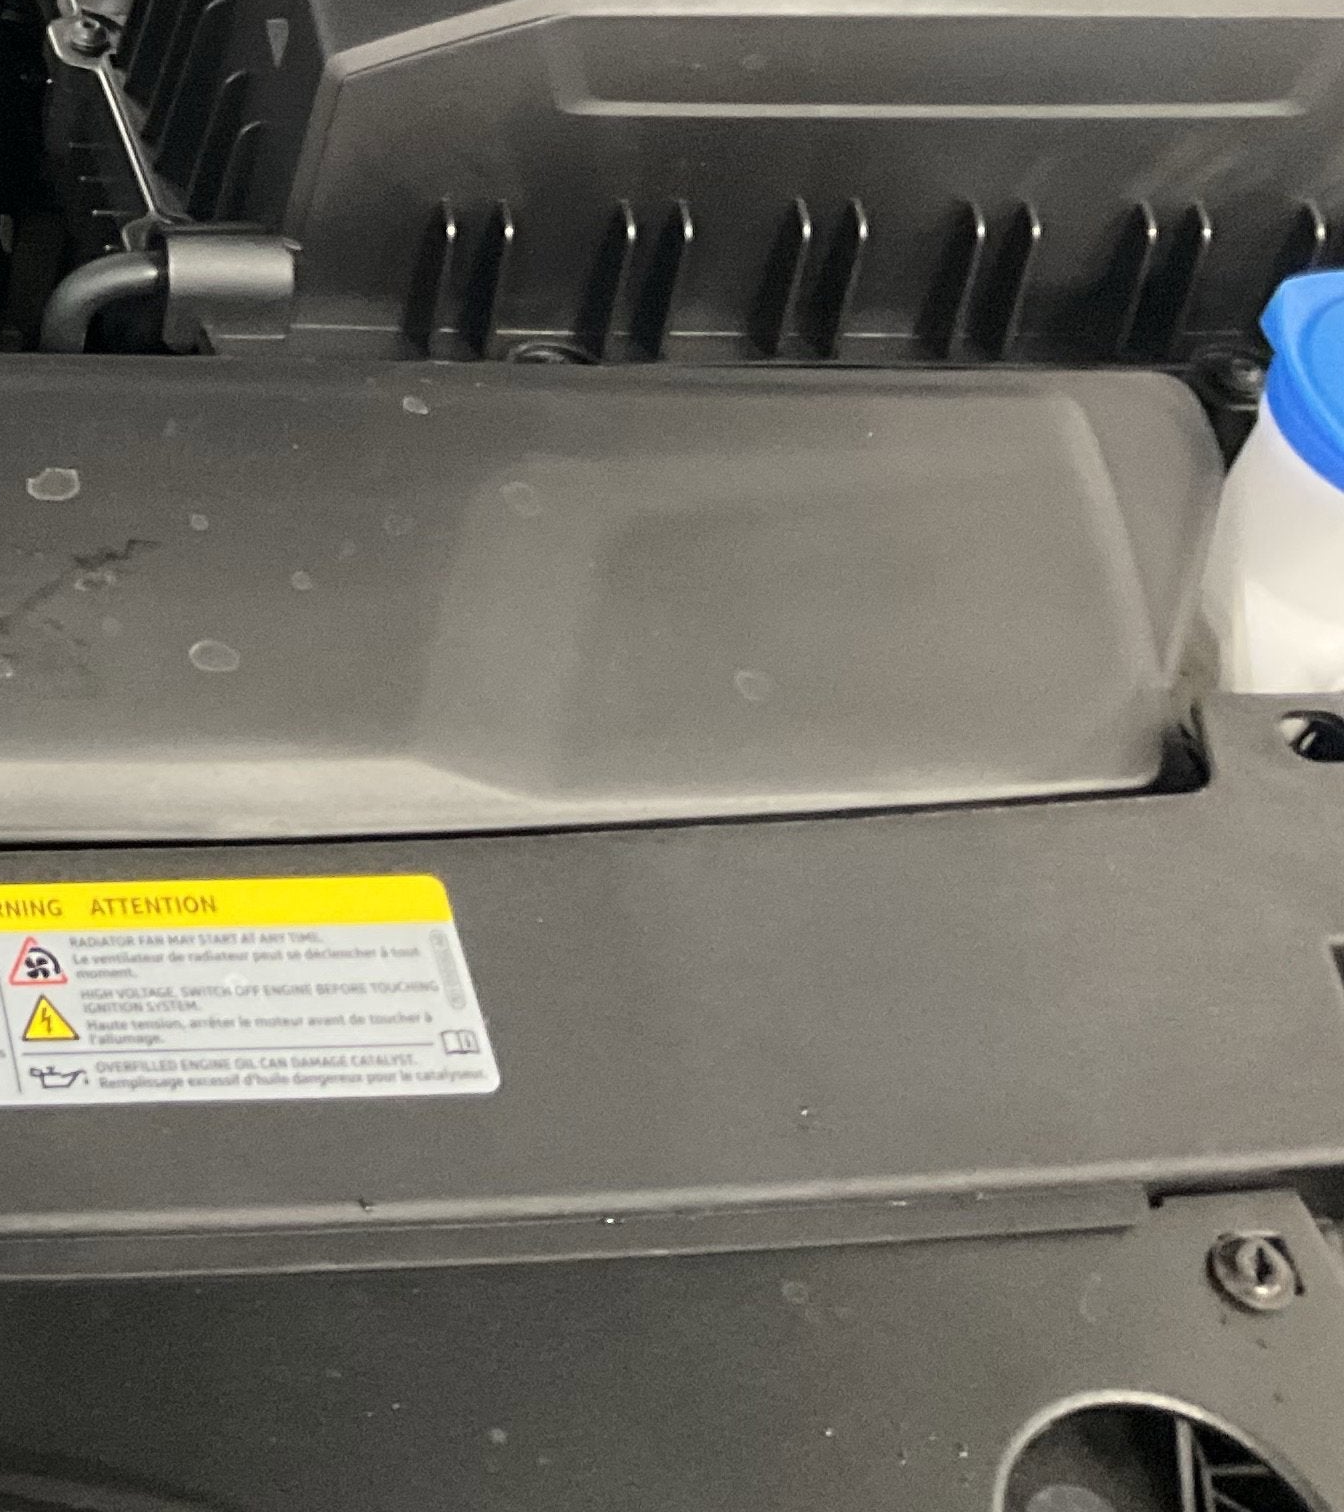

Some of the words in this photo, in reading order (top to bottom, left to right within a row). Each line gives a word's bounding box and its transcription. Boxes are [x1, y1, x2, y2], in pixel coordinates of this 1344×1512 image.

[90, 896, 217, 916] ATTENTION
[70, 937, 135, 948] RADIATOR
[139, 936, 163, 946] FAN
[168, 935, 195, 946] MAY
[199, 934, 237, 945] START
[240, 933, 255, 944] AT
[73, 955, 89, 965] Le
[168, 952, 183, 963] de
[81, 989, 113, 999] HIGH
